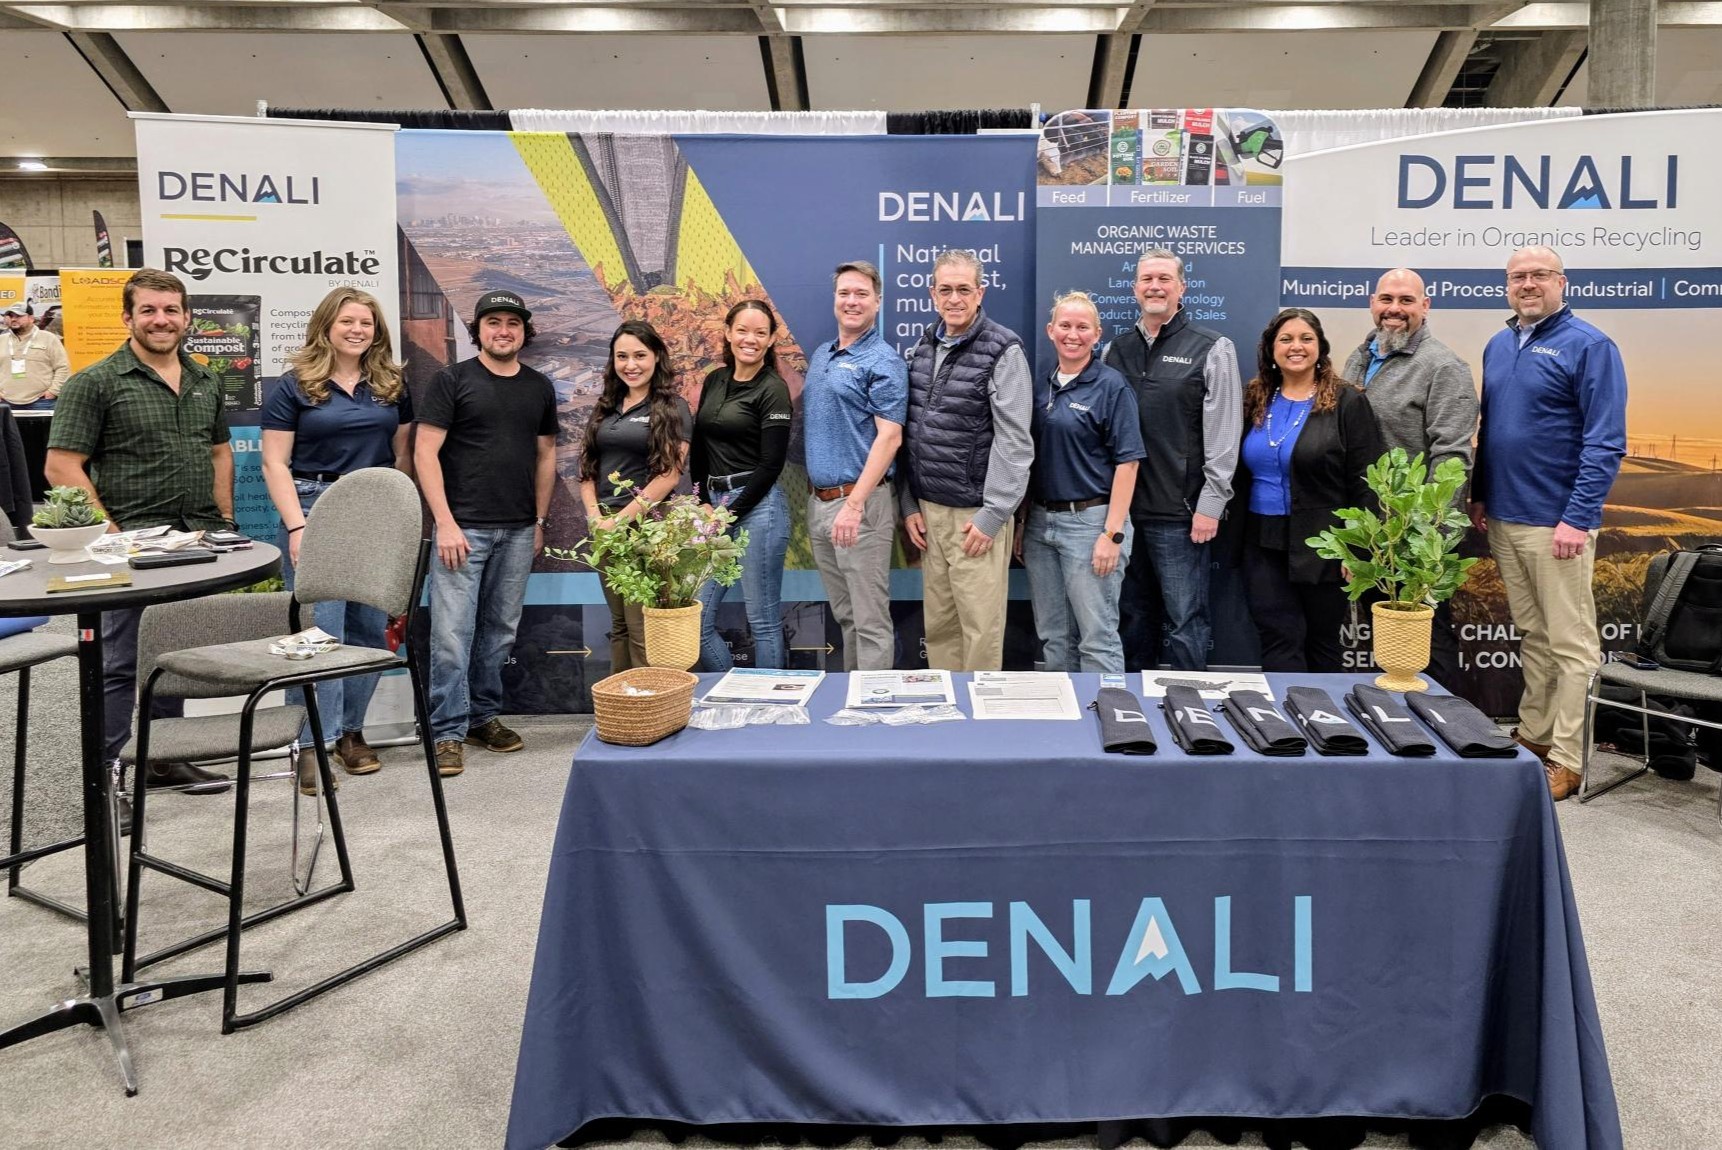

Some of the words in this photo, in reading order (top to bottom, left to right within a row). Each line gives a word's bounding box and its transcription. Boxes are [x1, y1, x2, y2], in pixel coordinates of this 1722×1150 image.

[158, 171, 320, 205] DENALI
[1397, 154, 1679, 210] DENALI
[1052, 191, 1086, 204] Feed
[1130, 190, 1191, 204] Fertilizer
[1237, 190, 1266, 204] Fuel
[878, 192, 1025, 222] DENALI
[1097, 225, 1164, 239] ORGANIC
[1167, 225, 1217, 239] WASTE
[1371, 226, 1452, 247] Leader
[1456, 227, 1476, 247] in
[1482, 226, 1586, 251] Organics
[1593, 226, 1702, 252] Recycling
[1071, 241, 1175, 255] MANAGEMENT
[1177, 241, 1246, 255] SERVICES
[163, 247, 380, 281] ReCirculate
[328, 279, 341, 288] BY
[343, 279, 380, 288] DENALI
[1282, 279, 1370, 299] Municipal
[1564, 281, 1653, 297] Industrial
[490, 296, 520, 306] DENALI
[1195, 308, 1227, 320] Sales
[187, 336, 241, 345] Sustainable
[271, 332, 295, 341] from
[183, 343, 245, 355] Compost
[1531, 345, 1560, 357] DENALI
[1162, 355, 1193, 365] DENALI
[1601, 622, 1632, 640] OF
[825, 895, 1313, 1000] DENALI
